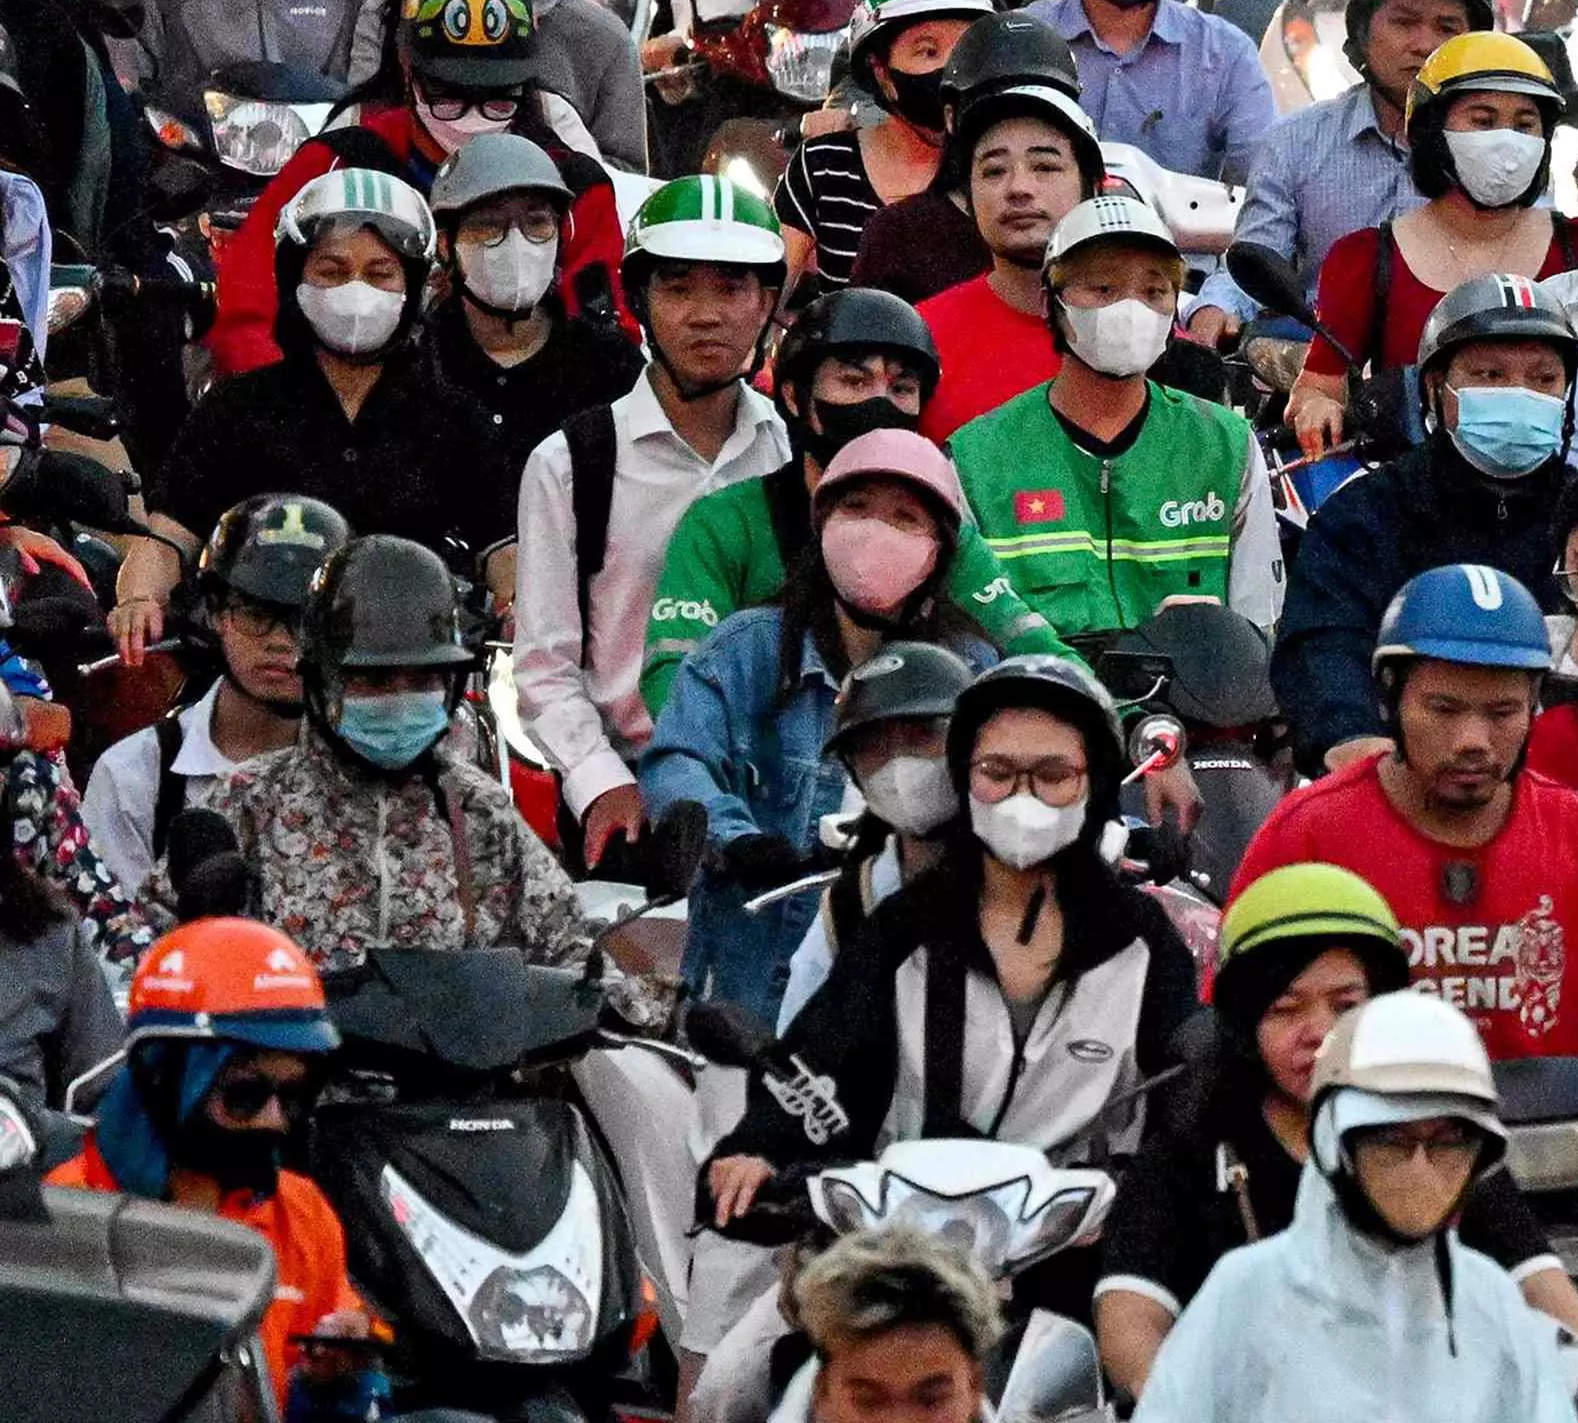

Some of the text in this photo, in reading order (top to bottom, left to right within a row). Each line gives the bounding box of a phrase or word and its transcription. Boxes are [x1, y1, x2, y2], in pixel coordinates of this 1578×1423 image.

[1159, 490, 1226, 529] Grab
[652, 597, 719, 627] Grab
[1192, 758, 1253, 770] HONDA
[1397, 925, 1524, 968] OREA
[1416, 977, 1524, 1012] GEND
[449, 1118, 515, 1131] HONDA
